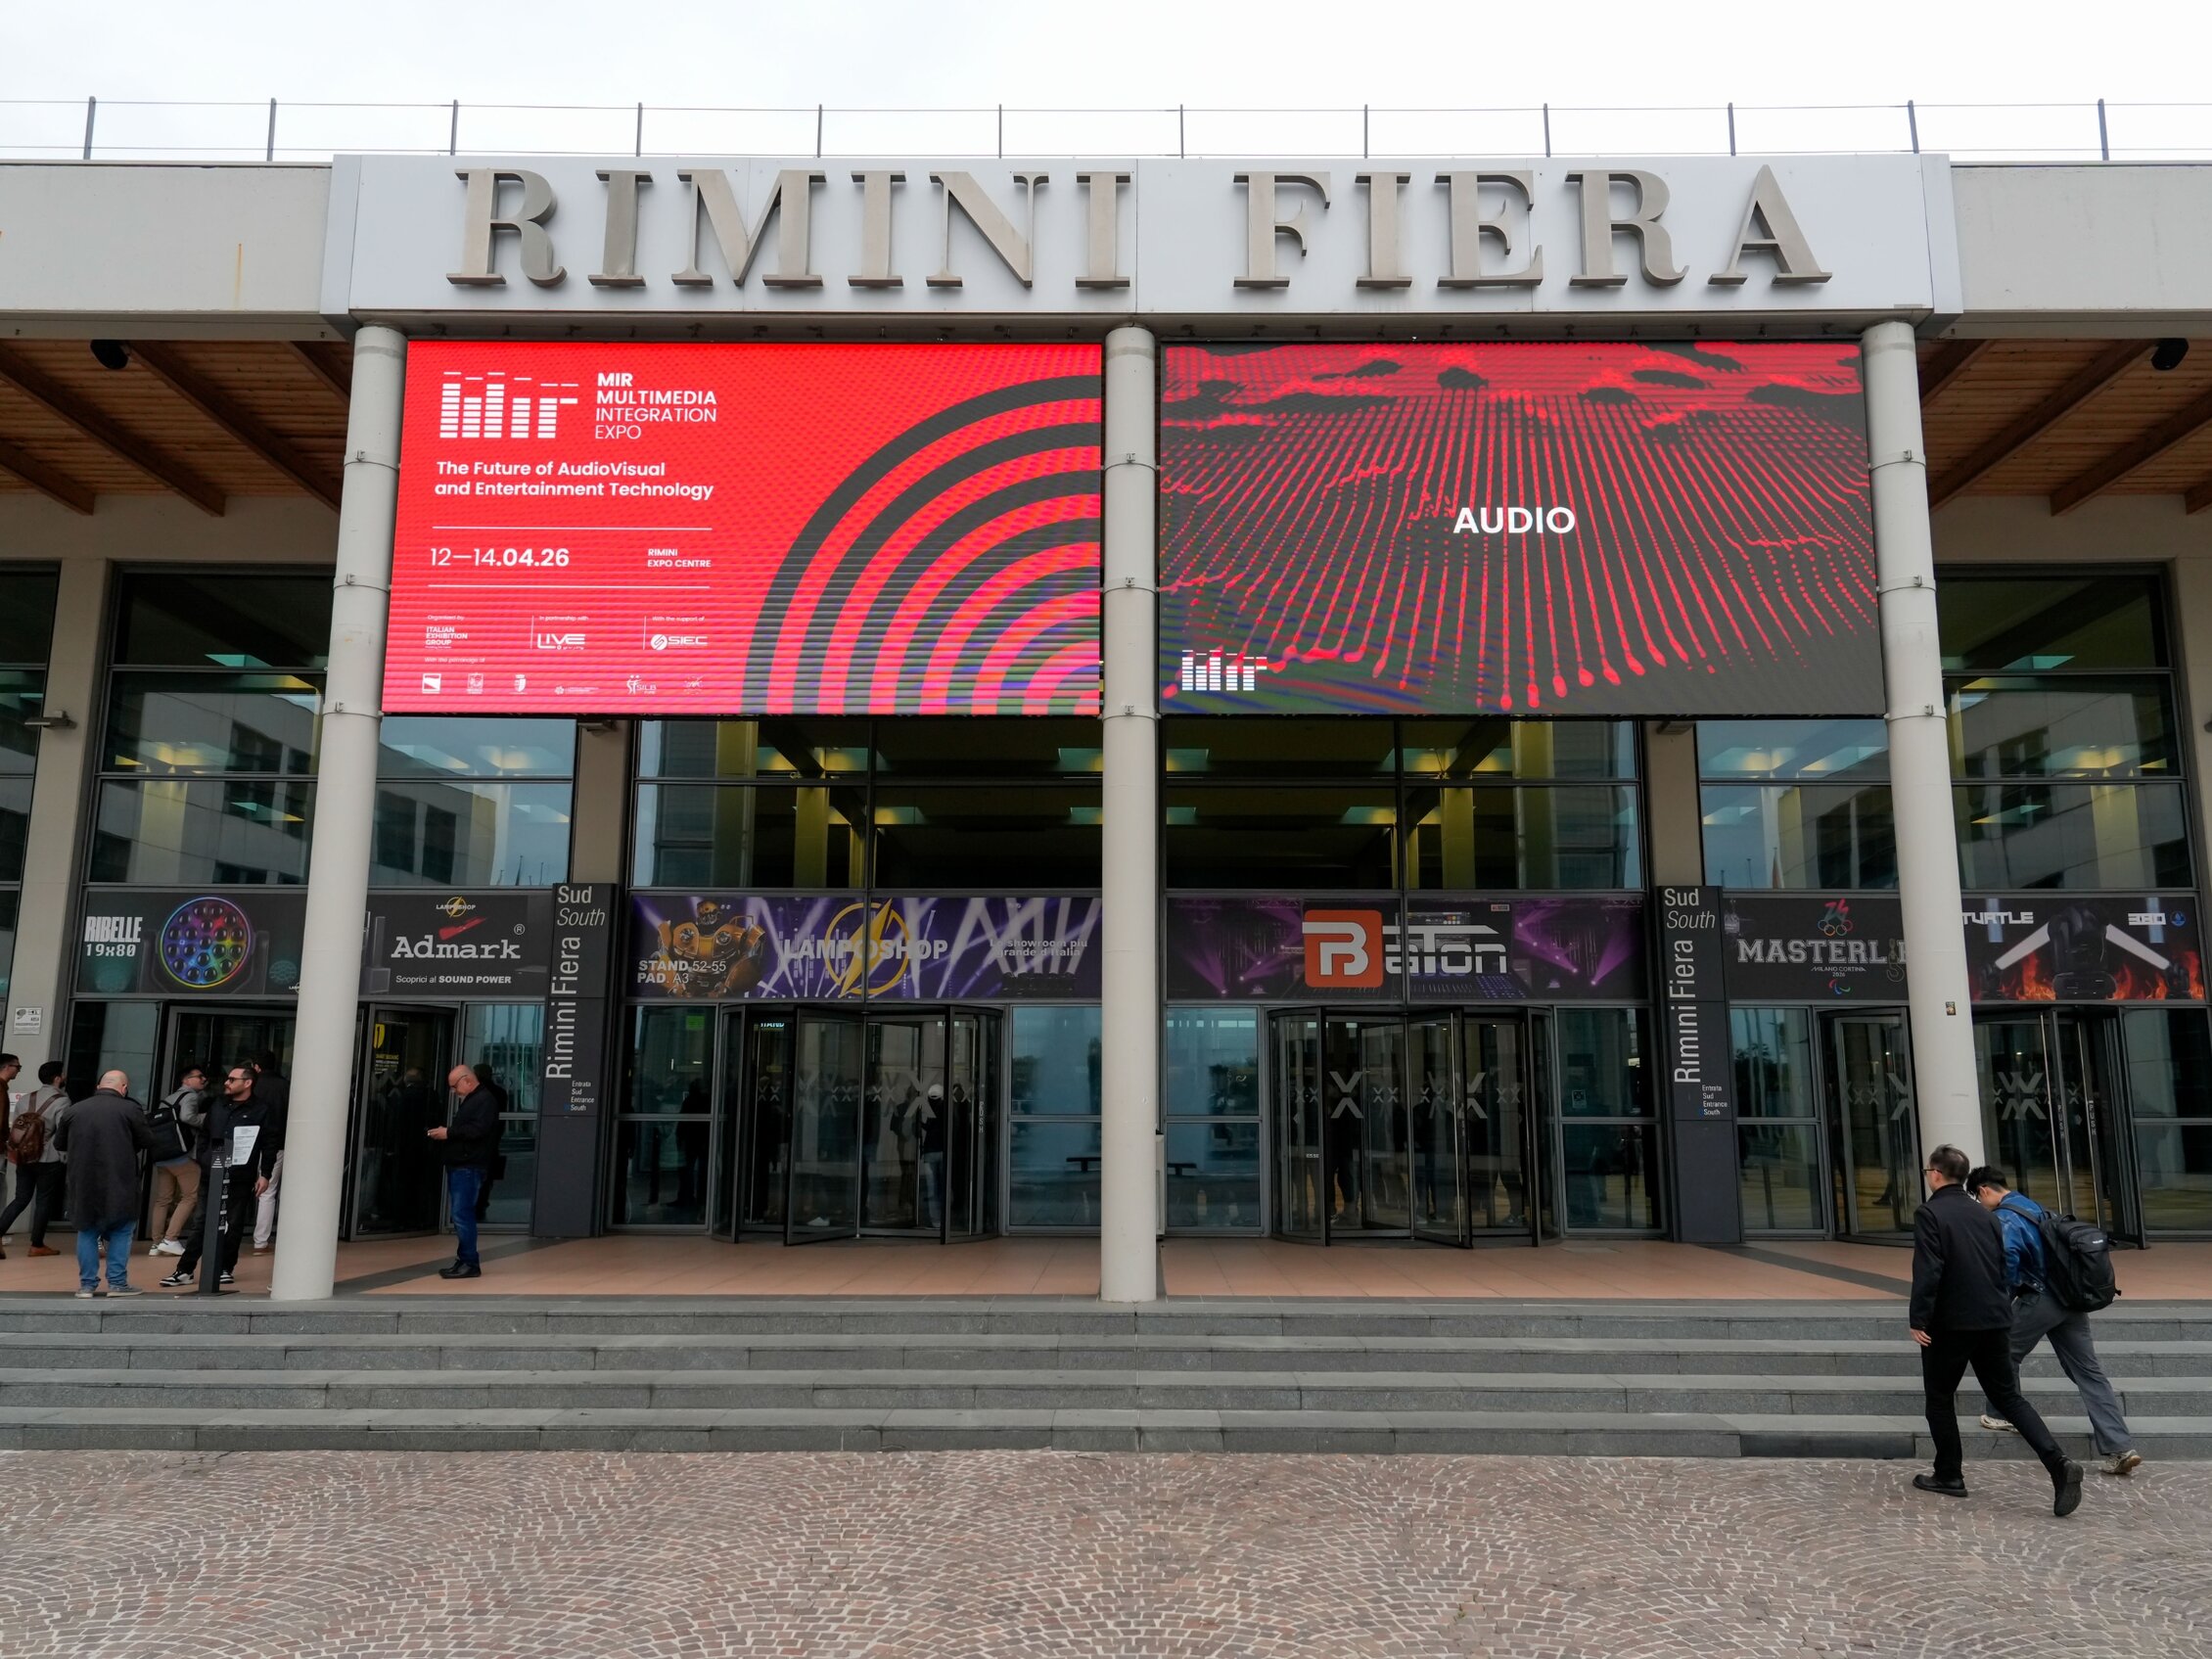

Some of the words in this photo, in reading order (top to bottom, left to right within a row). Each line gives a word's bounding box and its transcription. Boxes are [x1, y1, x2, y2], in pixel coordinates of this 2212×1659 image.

[446, 167, 1131, 288] RIMINI
[1233, 163, 1832, 288] FIERA
[598, 372, 634, 387] MIR
[596, 390, 717, 405] MULTIMEDIA
[595, 407, 717, 422] INTEGRATION
[595, 424, 642, 439] EXPO
[437, 461, 469, 476] The
[474, 461, 531, 476] Future
[535, 461, 554, 476] of
[557, 461, 666, 477] AudioVisual
[435, 481, 470, 495] and
[475, 481, 604, 496] Entertainment
[609, 482, 714, 501] Technology
[1452, 506, 1576, 534] AUDIO
[647, 548, 678, 557] RIMINI
[647, 559, 674, 567] EXPO
[676, 559, 712, 568] CENTRE
[537, 633, 586, 649] LIVE
[668, 636, 709, 645] SIEC
[557, 885, 593, 904] Sud
[1665, 888, 1699, 907] Sud
[556, 907, 606, 926] South
[1666, 910, 1716, 929] South
[1961, 911, 2034, 925] TURTLE
[84, 916, 143, 943] RIBELLE
[85, 943, 137, 957] 19x80
[996, 948, 1036, 957] grande
[551, 937, 581, 994] Fiera
[692, 960, 727, 972] 52-55
[1669, 939, 1696, 999] Fiera
[396, 975, 427, 984] Scoprici
[673, 973, 689, 983] A3
[545, 1002, 577, 1078] Rimini
[1670, 1005, 1701, 1083] Rimini
